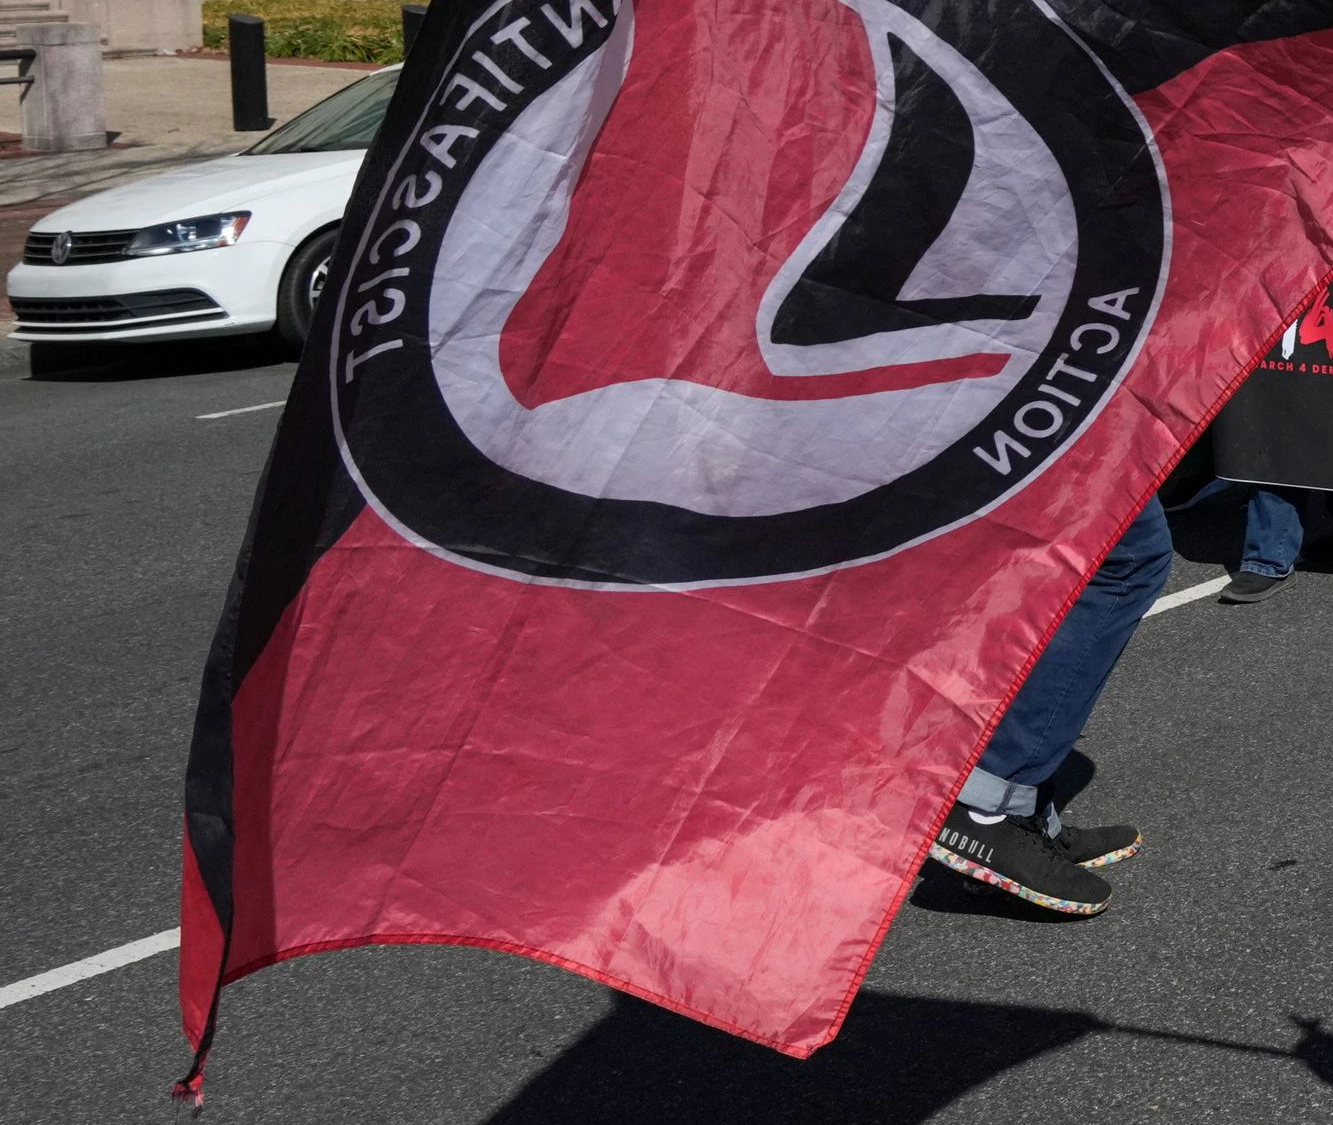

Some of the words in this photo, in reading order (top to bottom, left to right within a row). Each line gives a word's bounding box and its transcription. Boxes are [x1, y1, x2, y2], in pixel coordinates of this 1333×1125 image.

[1257, 360, 1294, 372] ARCH
[1299, 363, 1307, 372] 4
[938, 827, 996, 865] NOBULL
